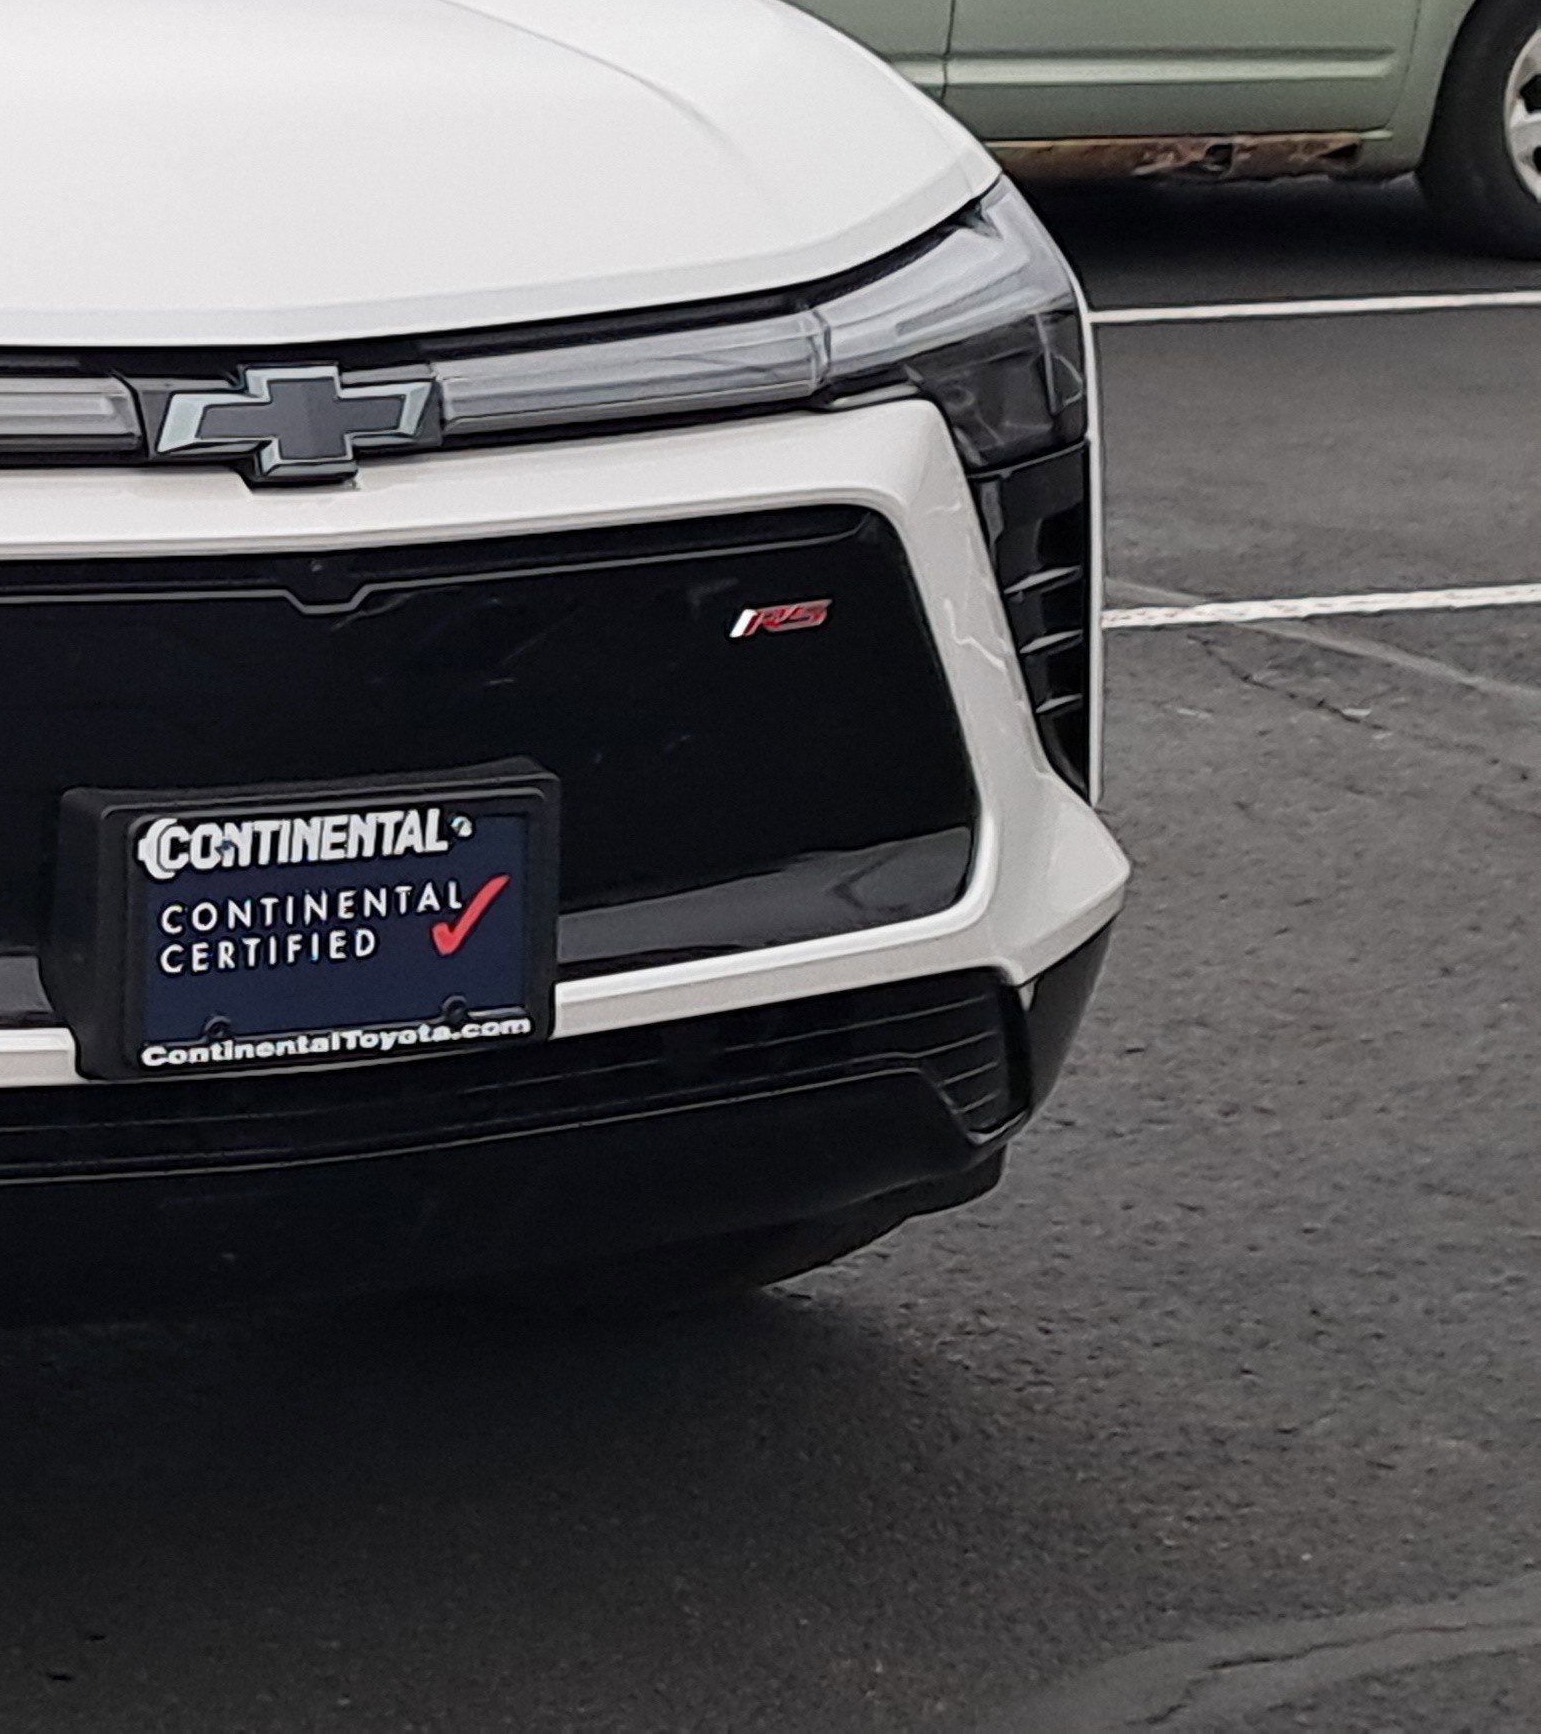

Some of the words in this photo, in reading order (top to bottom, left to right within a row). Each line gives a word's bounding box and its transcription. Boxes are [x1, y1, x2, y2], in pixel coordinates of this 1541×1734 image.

[739, 598, 833, 637] RS
[138, 807, 450, 880] CONTINENTAL
[160, 880, 463, 935] CONTINENTAL
[160, 927, 377, 975] CERTIFIED
[140, 1015, 531, 1068] ContinentalToyota.com
